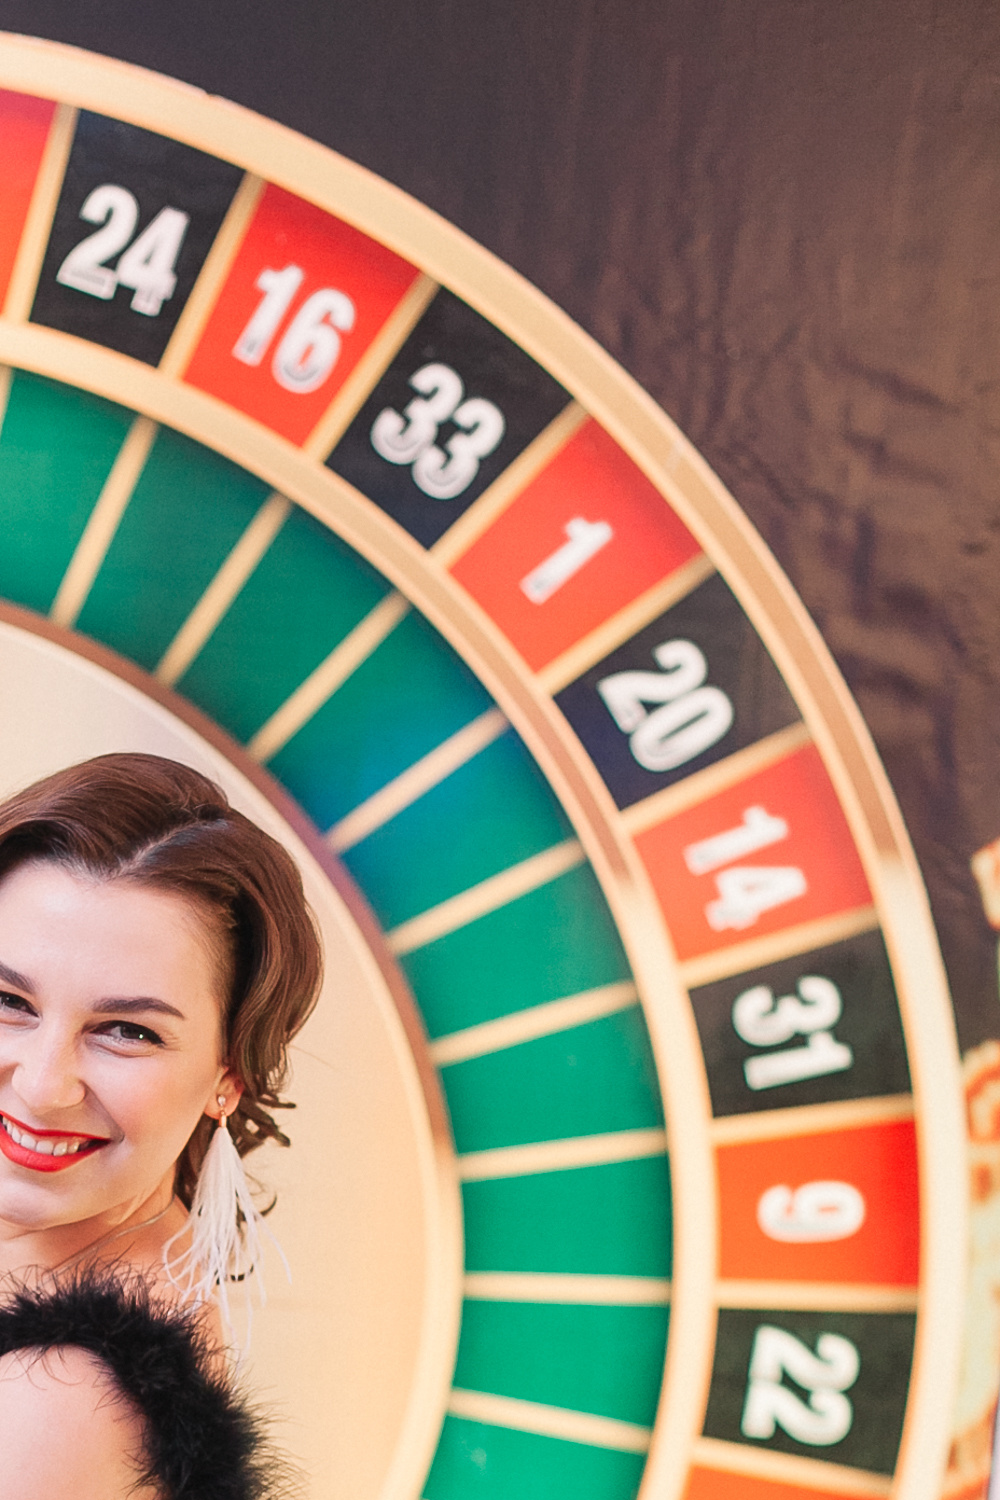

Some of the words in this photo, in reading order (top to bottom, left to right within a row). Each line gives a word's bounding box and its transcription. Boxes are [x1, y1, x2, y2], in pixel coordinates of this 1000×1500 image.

[56, 184, 190, 317] 24
[231, 265, 355, 394] 16
[371, 362, 505, 499] 33
[520, 517, 613, 605] 1
[598, 638, 734, 772] 20
[684, 805, 807, 931] 14
[732, 975, 852, 1091] 31
[756, 1180, 866, 1242] 9
[741, 1325, 860, 1446] 22
